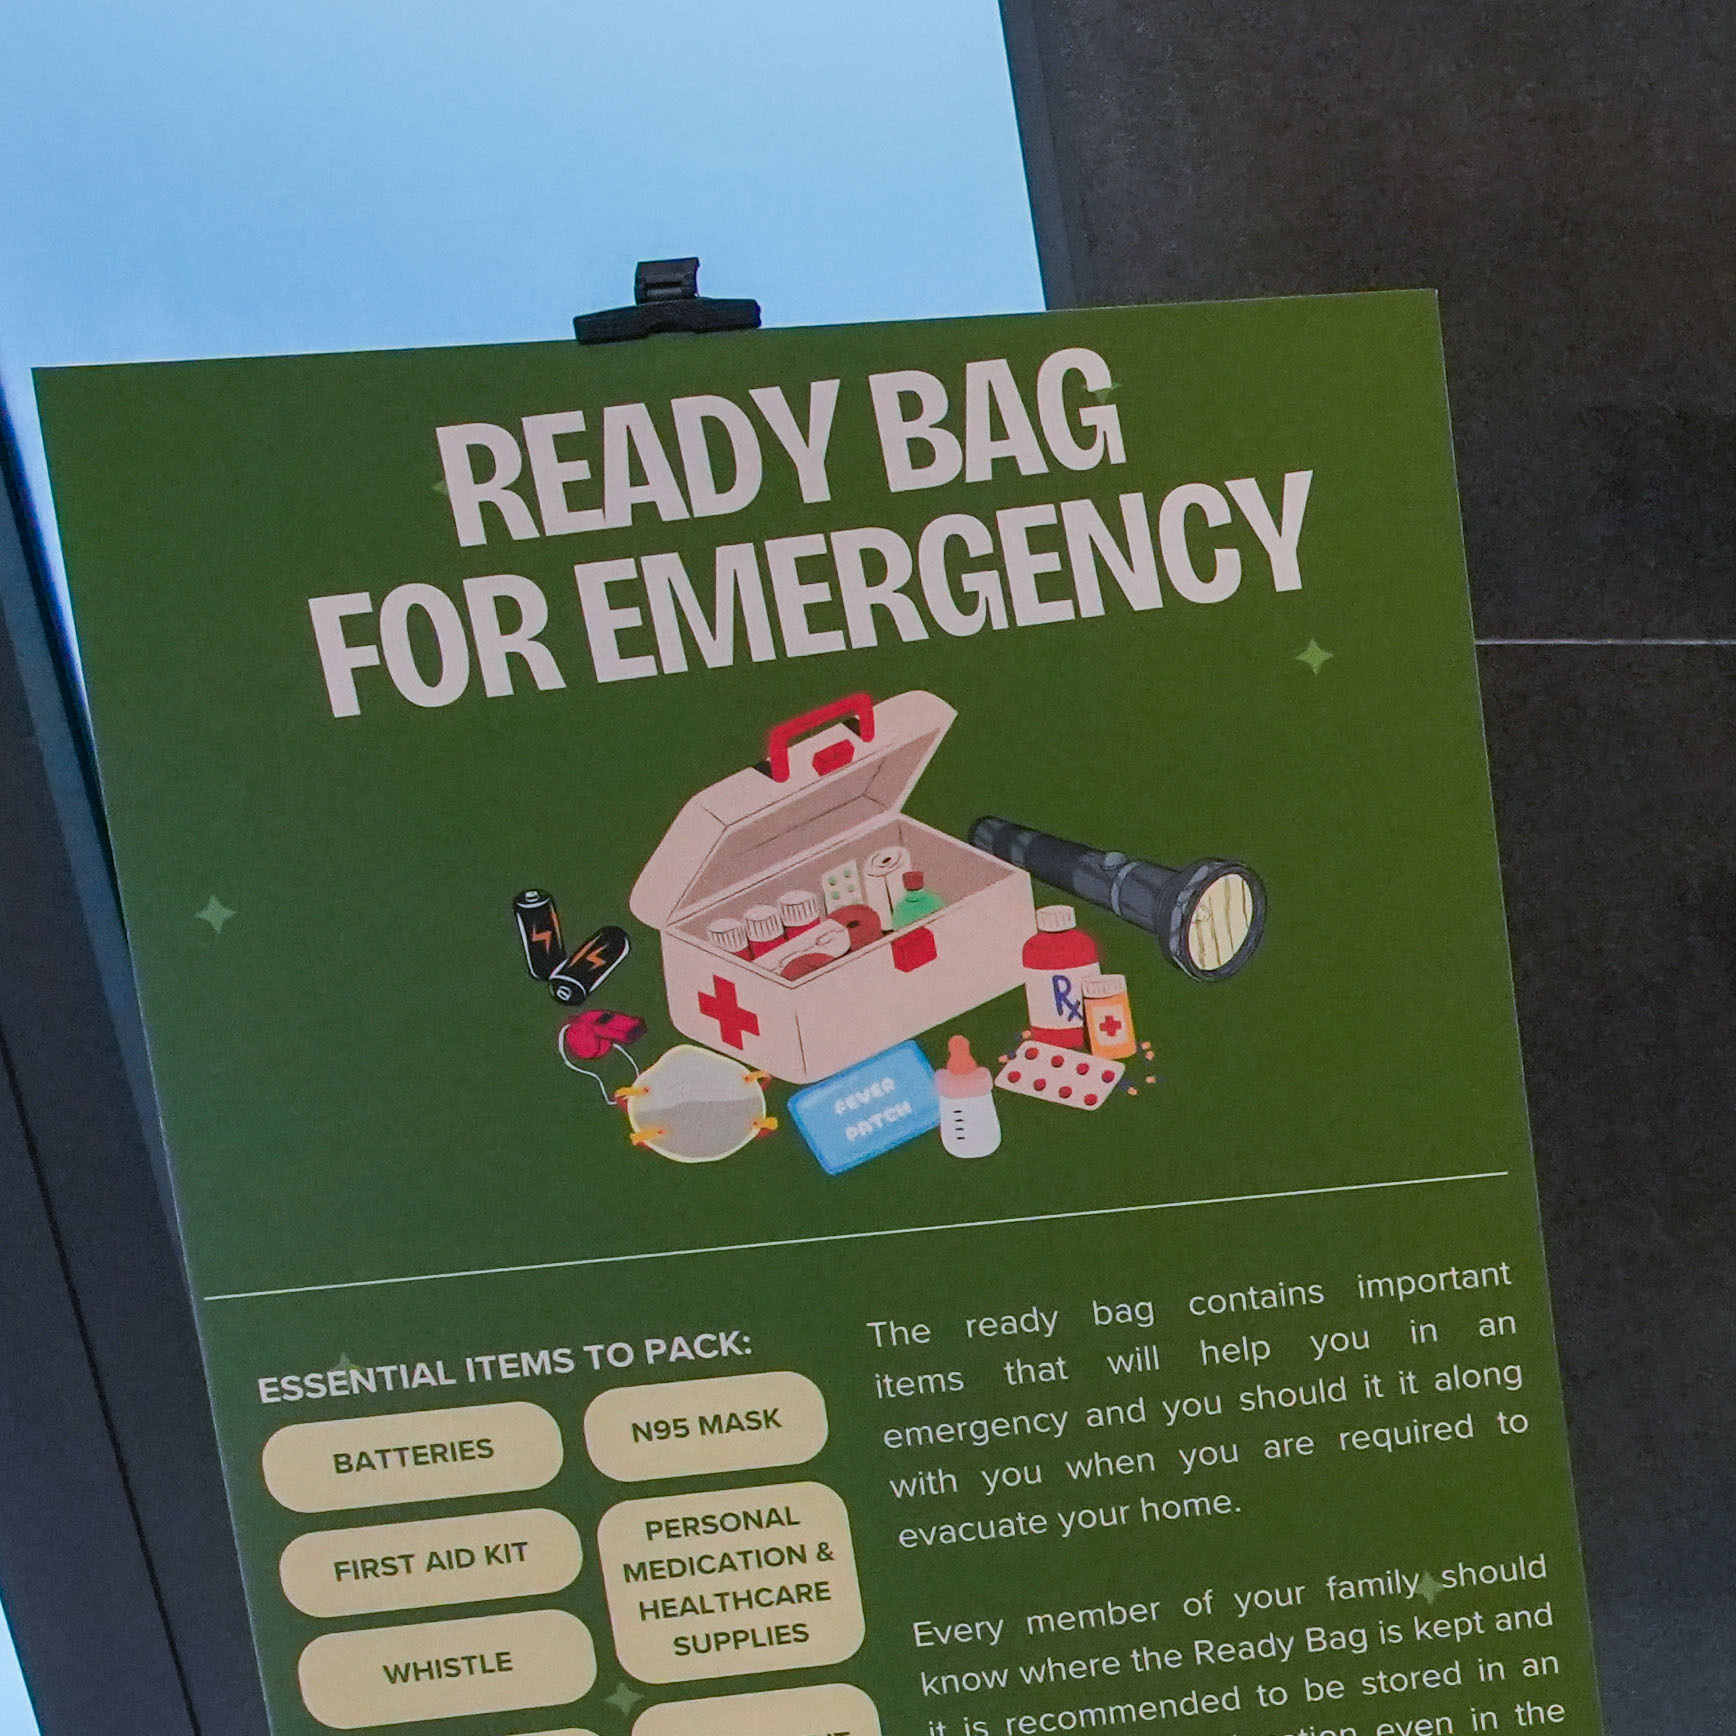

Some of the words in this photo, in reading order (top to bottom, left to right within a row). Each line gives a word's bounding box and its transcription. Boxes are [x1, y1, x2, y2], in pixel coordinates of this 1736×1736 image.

[435, 378, 841, 548] READY
[868, 347, 1127, 493] BAG
[307, 574, 567, 719] FOR
[573, 469, 1314, 684] EMERGENCY
[1052, 974, 1084, 1022] Rx
[834, 1076, 896, 1116] FEVER
[845, 1101, 912, 1141] PATCH
[866, 1320, 931, 1348] The
[965, 1305, 1058, 1339] ready
[1092, 1300, 1155, 1328] bag
[1188, 1281, 1325, 1316] contains
[1357, 1261, 1513, 1302] important
[257, 1360, 457, 1404] ESSENTIAL
[465, 1347, 575, 1383] ITEMS
[582, 1341, 634, 1370] TO
[644, 1330, 752, 1365] PACK:
[874, 1371, 965, 1399] items
[1003, 1356, 1069, 1386] that
[1106, 1344, 1160, 1375] will
[1200, 1335, 1271, 1367] help
[1309, 1330, 1370, 1361] you
[1409, 1319, 1438, 1344] in
[1479, 1315, 1516, 1337] an
[631, 1417, 690, 1444] N95
[698, 1407, 783, 1436] MASK
[883, 1410, 1068, 1449] emergency
[1086, 1396, 1146, 1428] and
[1161, 1395, 1222, 1427] you
[1239, 1375, 1347, 1412] should
[1364, 1374, 1385, 1399] it
[1399, 1370, 1419, 1395] it
[1434, 1364, 1523, 1392] along
[332, 1438, 495, 1474] BATTERIES
[889, 1468, 958, 1499] with
[981, 1464, 1042, 1496] you
[1065, 1451, 1156, 1480] when
[1178, 1443, 1239, 1475] you
[1264, 1435, 1315, 1459] are
[1339, 1412, 1474, 1453] required
[1496, 1411, 1529, 1435] to
[645, 1505, 801, 1541] PERSONAL
[898, 1511, 1048, 1549] evacuate
[1057, 1505, 1130, 1538] your
[1140, 1494, 1241, 1523] home.
[333, 1553, 416, 1582] FIRST
[426, 1548, 476, 1573] AID
[484, 1541, 528, 1566] KIT
[622, 1544, 807, 1584] MEDICATION
[816, 1541, 835, 1562] &
[639, 1580, 832, 1622] HEALTHCARE
[912, 1618, 1004, 1648] Every
[1026, 1600, 1161, 1635] member
[1183, 1588, 1213, 1617] of
[1233, 1585, 1306, 1619] your
[1325, 1568, 1420, 1601] family
[1441, 1553, 1547, 1589] should
[673, 1622, 810, 1657] SUPPLIES
[920, 1668, 1009, 1697] know
[1018, 1656, 1121, 1685] where
[1130, 1646, 1183, 1673] the
[1194, 1631, 1295, 1665] Ready
[1305, 1626, 1368, 1655] Bag
[1378, 1620, 1404, 1645] is
[1413, 1611, 1486, 1643] kept
[1495, 1601, 1553, 1632] and
[382, 1651, 514, 1685] WHISTLE
[1005, 1685, 1241, 1736] recommended
[1255, 1684, 1288, 1708] to
[1304, 1677, 1345, 1702] be
[1361, 1660, 1462, 1696] stored
[1477, 1657, 1505, 1682] in
[1522, 1655, 1559, 1677] an
[1470, 1707, 1498, 1732] in
[1514, 1700, 1565, 1727] the
